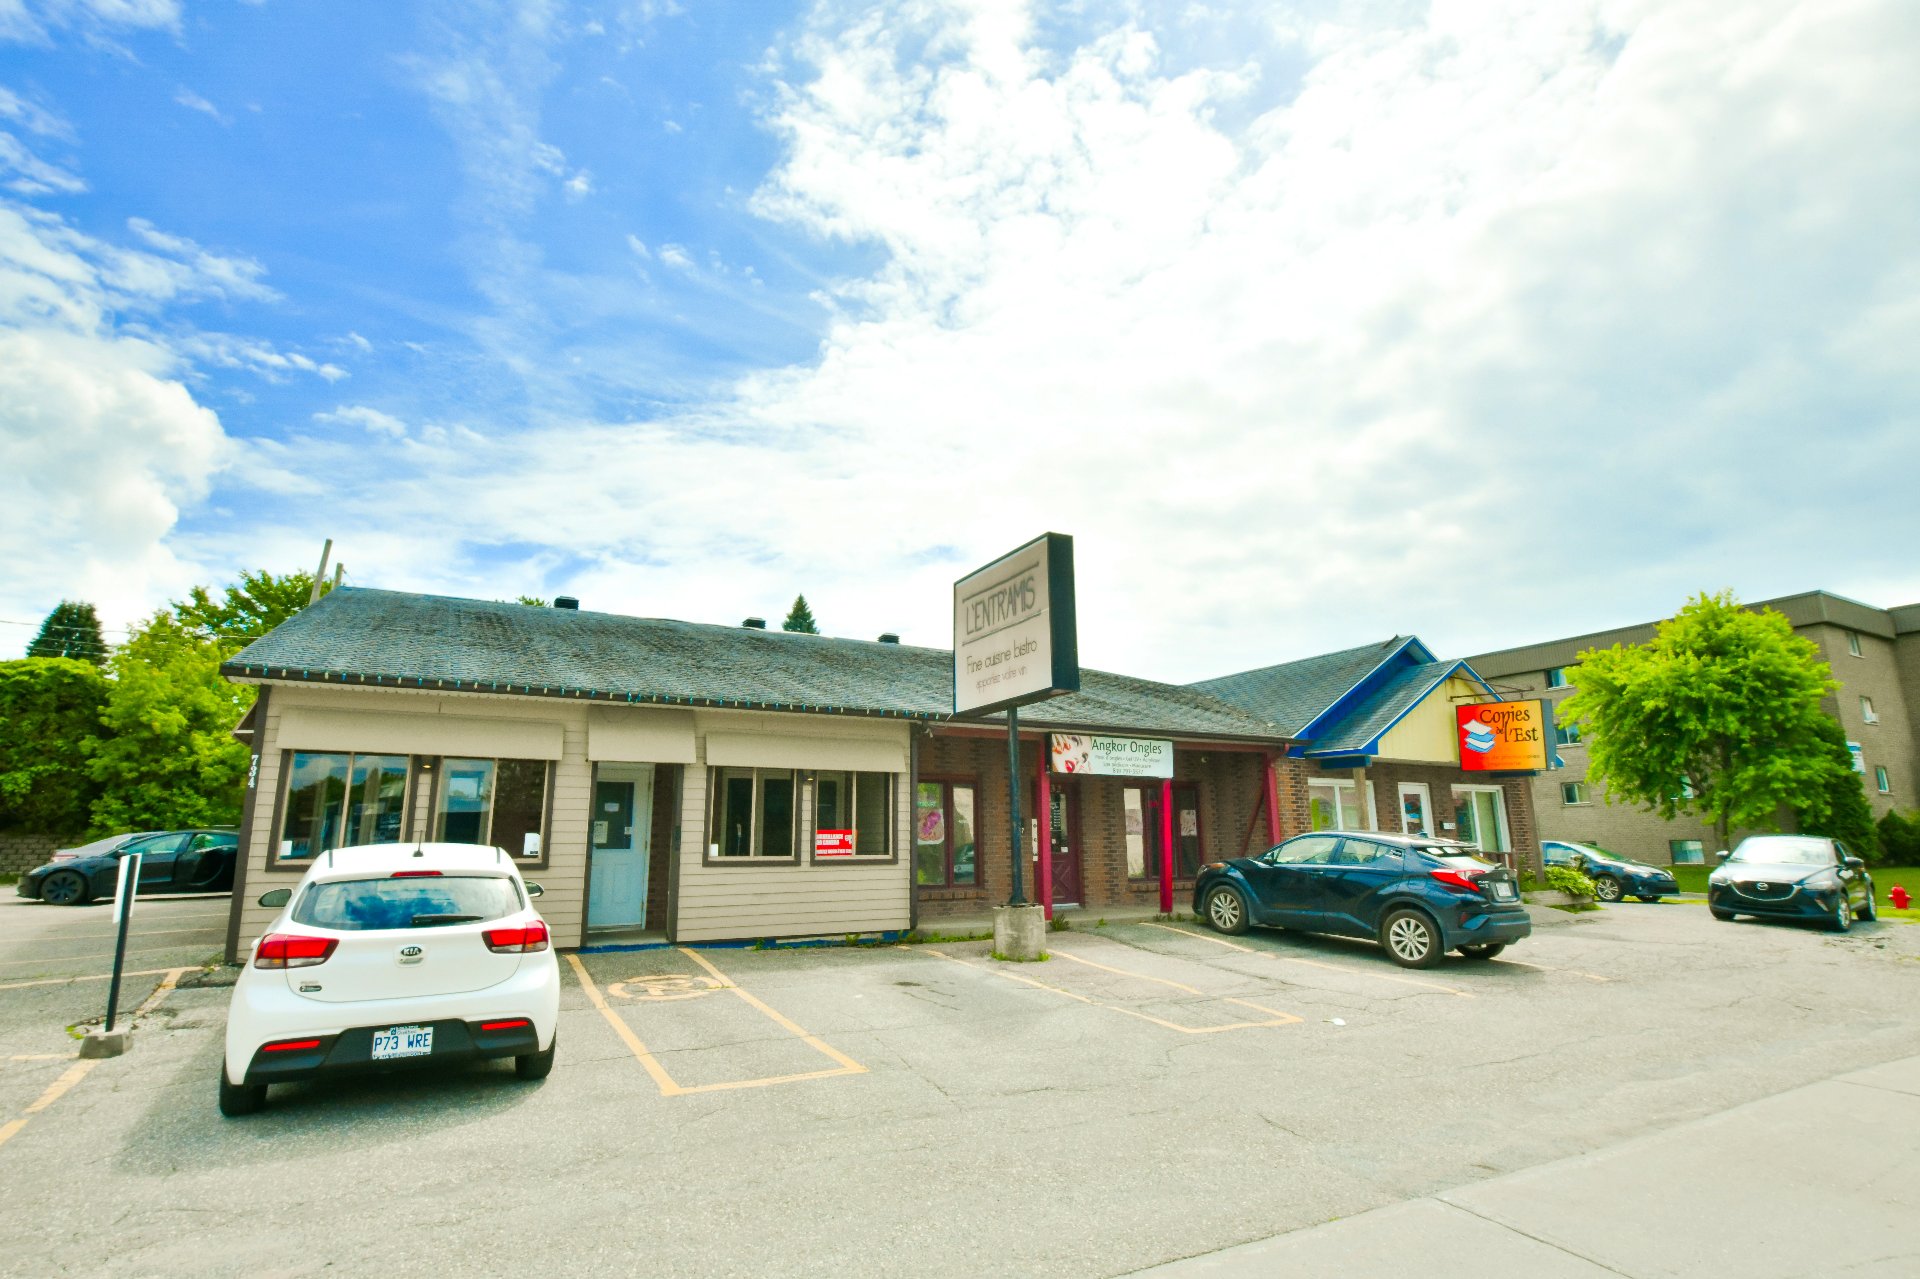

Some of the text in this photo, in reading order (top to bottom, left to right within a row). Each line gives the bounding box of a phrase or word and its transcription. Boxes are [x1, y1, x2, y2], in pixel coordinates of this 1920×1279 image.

[966, 635, 1038, 675] Fine cuisine bistro
[1479, 705, 1531, 728] Copies
[1495, 726, 1504, 735] de
[1091, 739, 1162, 757] Angkor Ongles
[402, 947, 420, 955] KIA
[373, 1032, 432, 1052] P73 WRE
